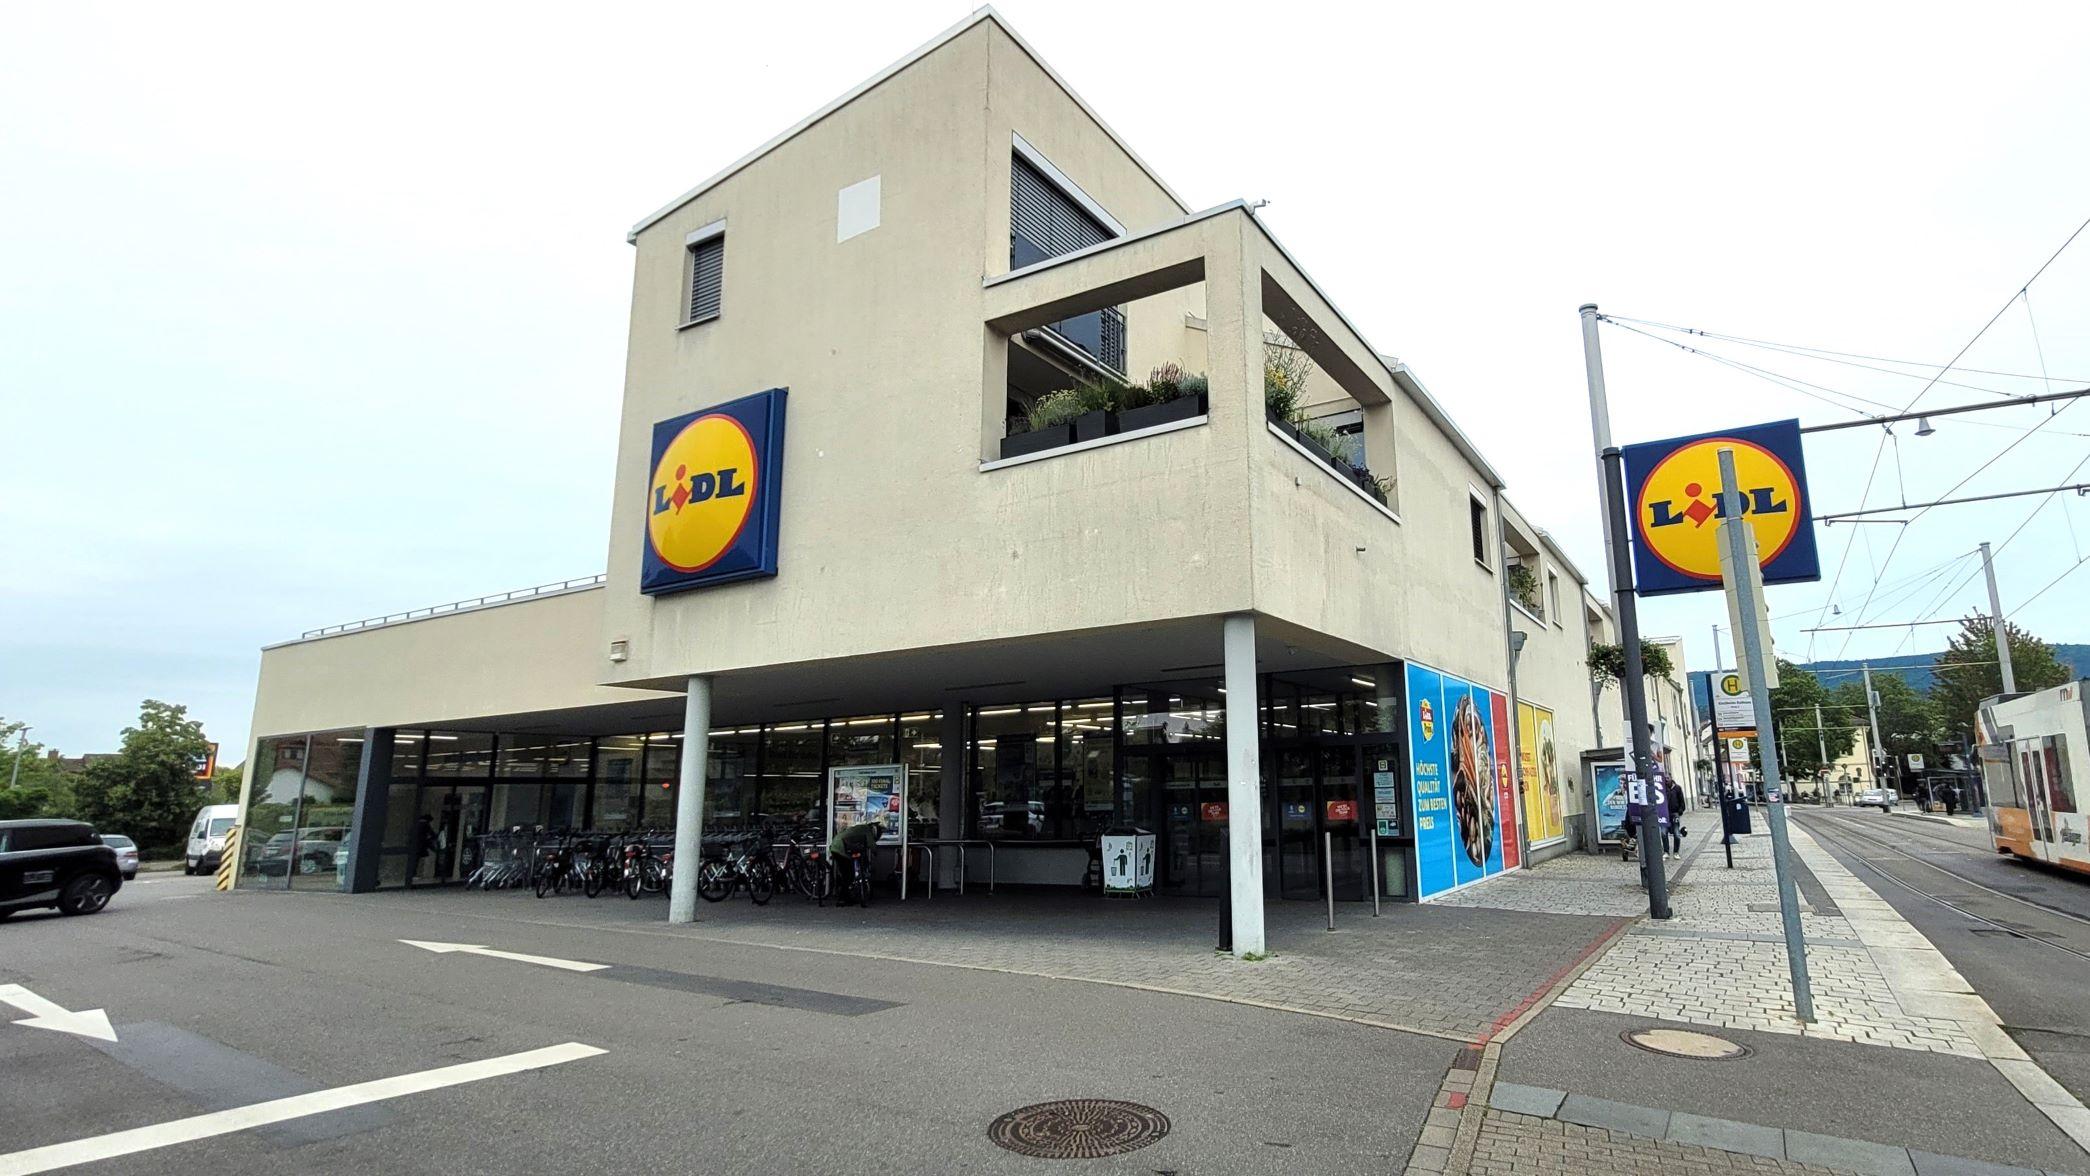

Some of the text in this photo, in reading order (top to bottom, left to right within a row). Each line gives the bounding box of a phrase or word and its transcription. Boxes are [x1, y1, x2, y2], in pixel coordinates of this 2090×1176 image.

[1416, 760, 1438, 776] HÖCHSTE
[1417, 778, 1441, 797] QUALITÄT
[1418, 797, 1447, 812] ZUM BESTEN
[1419, 816, 1434, 830] PREIS
